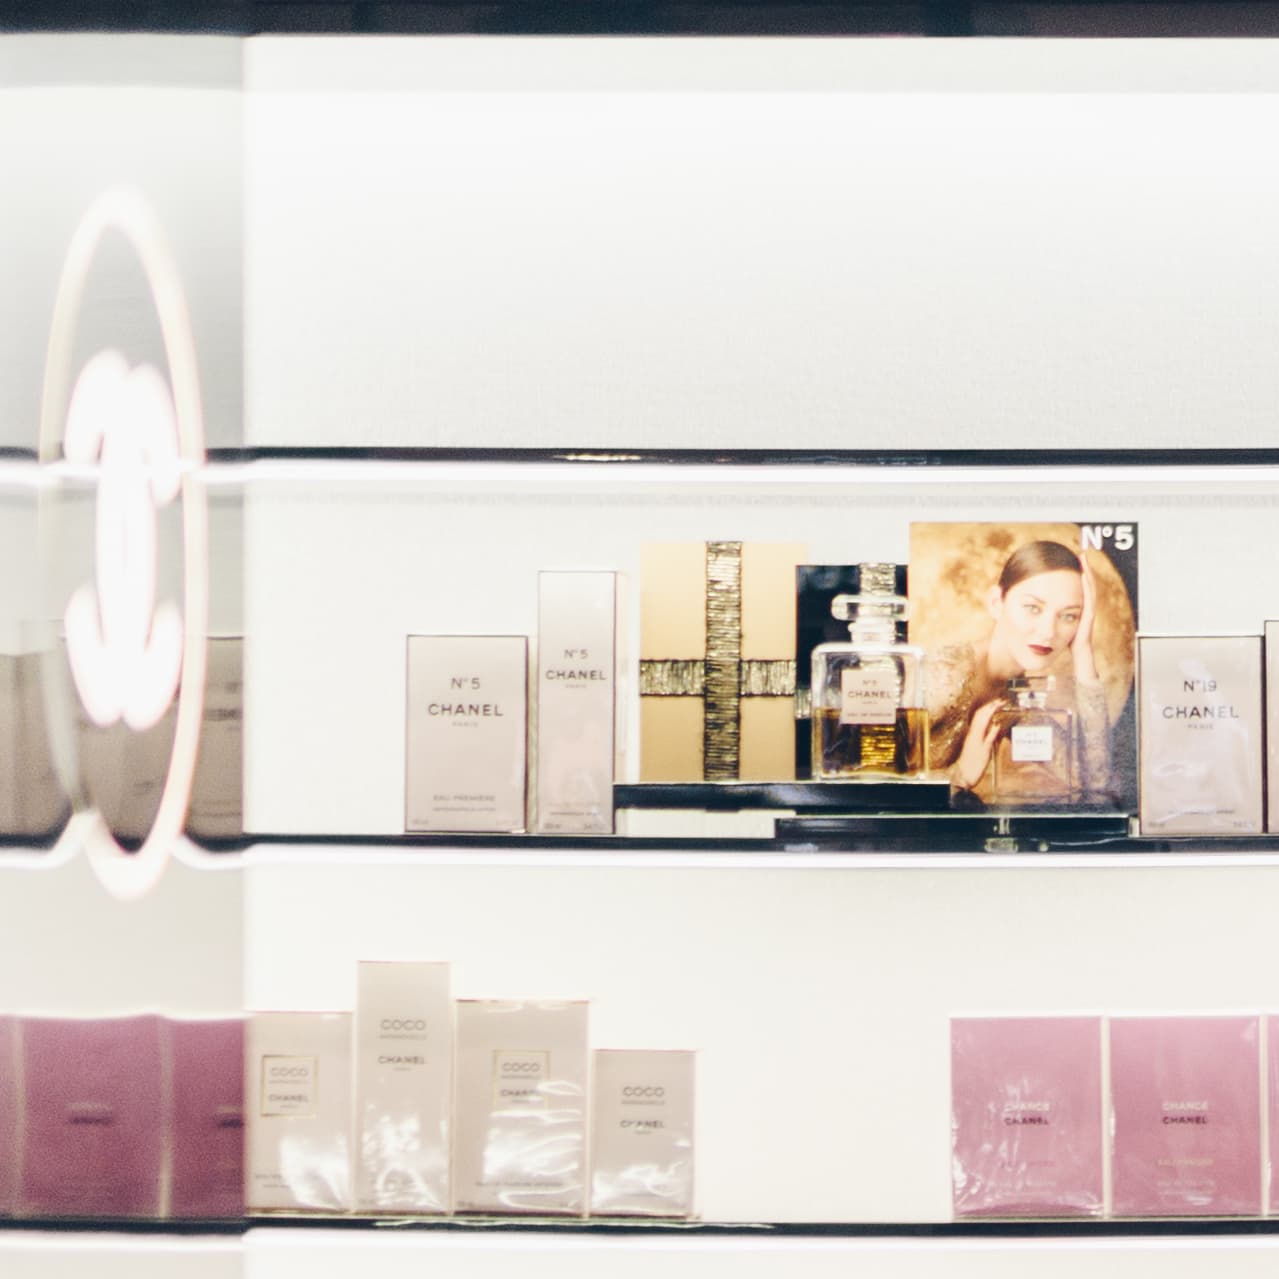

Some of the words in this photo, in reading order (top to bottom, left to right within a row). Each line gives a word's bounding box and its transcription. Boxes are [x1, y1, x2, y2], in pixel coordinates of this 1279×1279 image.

[1080, 525, 1134, 551] N°5
[545, 670, 607, 681] CHANEL
[427, 703, 504, 717] CHANEL
[1162, 706, 1240, 720] CHANEL
[380, 1019, 427, 1031] COCO
[378, 1055, 426, 1065] CHANEL
[502, 1062, 541, 1072] COCO
[622, 1086, 665, 1097] COCO
[1162, 1116, 1208, 1125] CHANEL
